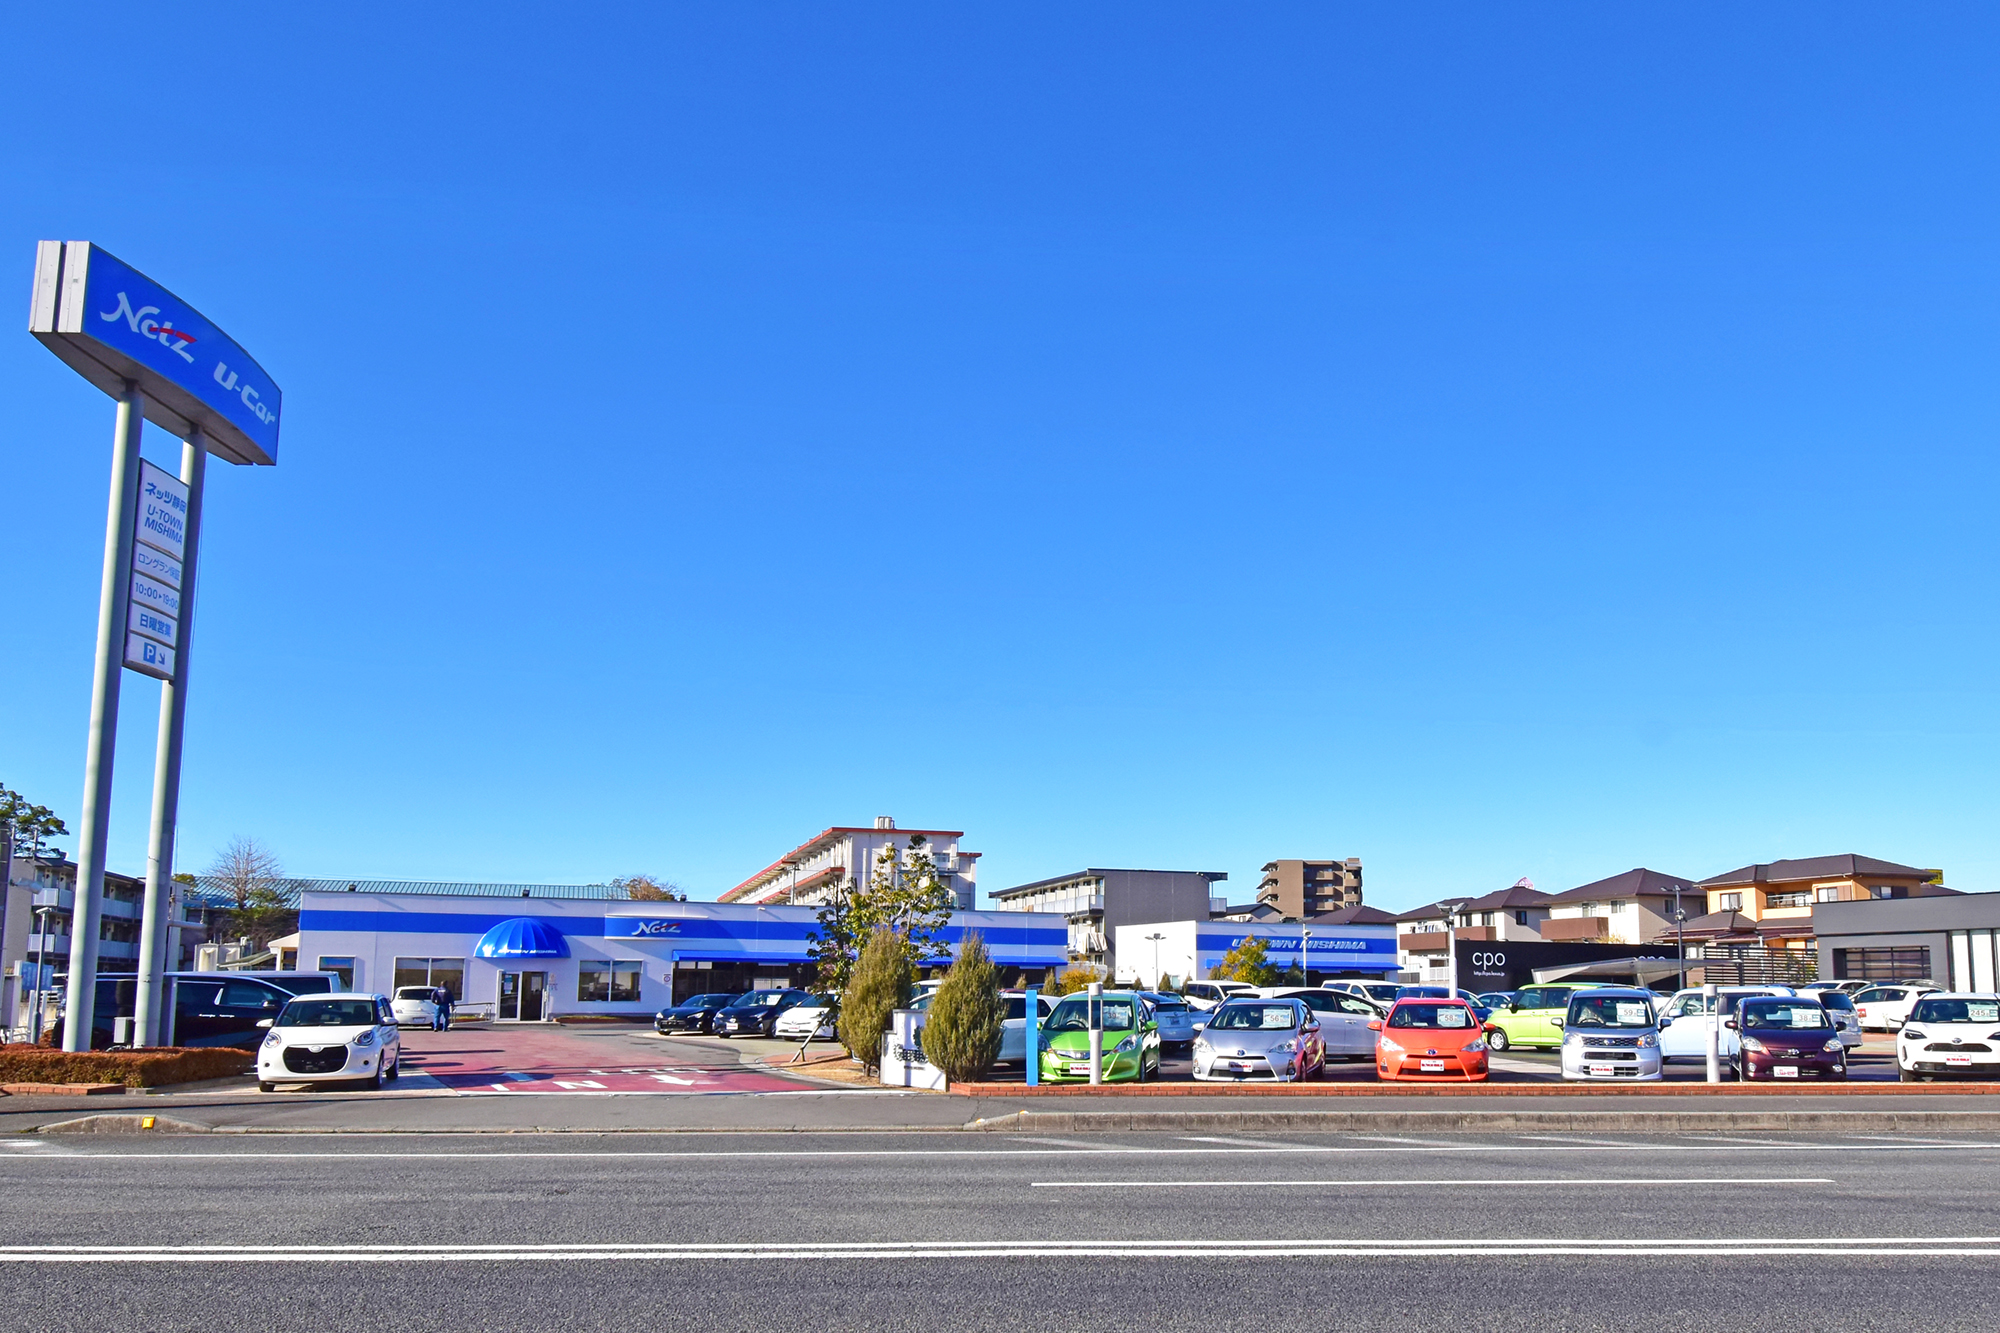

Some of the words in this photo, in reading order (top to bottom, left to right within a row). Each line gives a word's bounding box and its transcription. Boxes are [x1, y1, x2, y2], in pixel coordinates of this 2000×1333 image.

[100, 291, 198, 363] Netz
[213, 361, 275, 425] U-Car
[147, 504, 183, 532] U-TOWN
[144, 517, 182, 545] MISHIMA
[135, 582, 158, 600] 10:00
[631, 920, 682, 936] Netz
[1472, 952, 1506, 971] cpo
